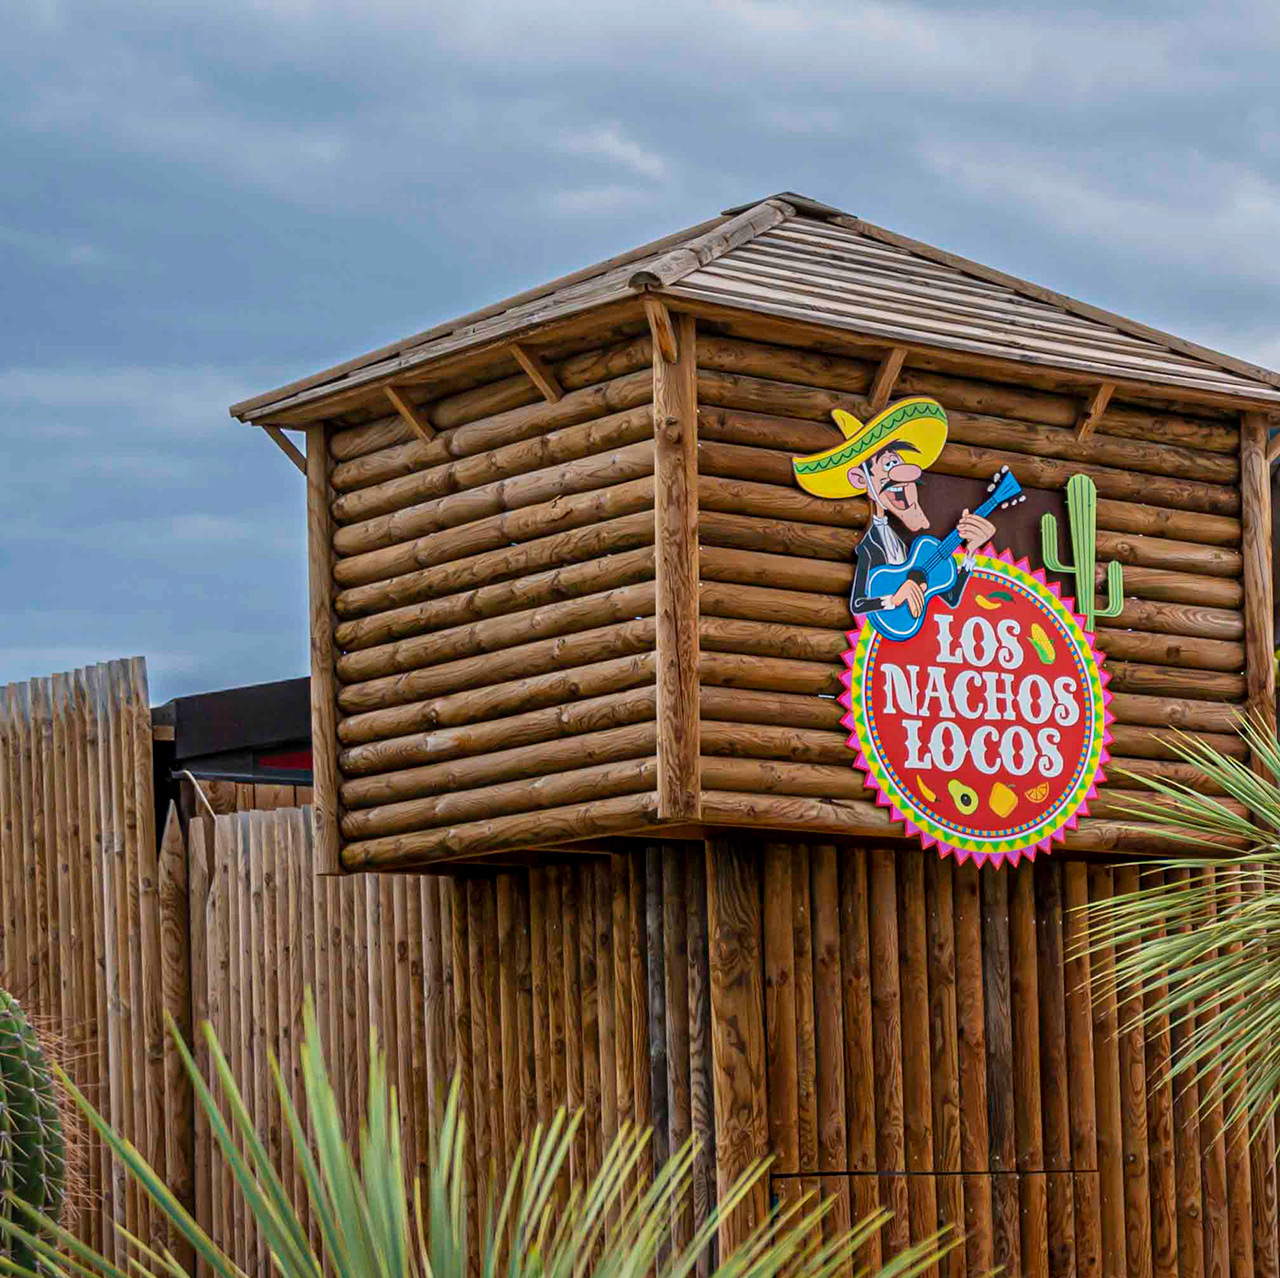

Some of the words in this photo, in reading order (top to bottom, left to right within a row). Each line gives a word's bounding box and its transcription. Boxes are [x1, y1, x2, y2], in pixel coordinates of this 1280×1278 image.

[933, 613, 1024, 670] LOS
[880, 663, 1080, 727] NACHOS
[902, 719, 1064, 778] LOCOS
